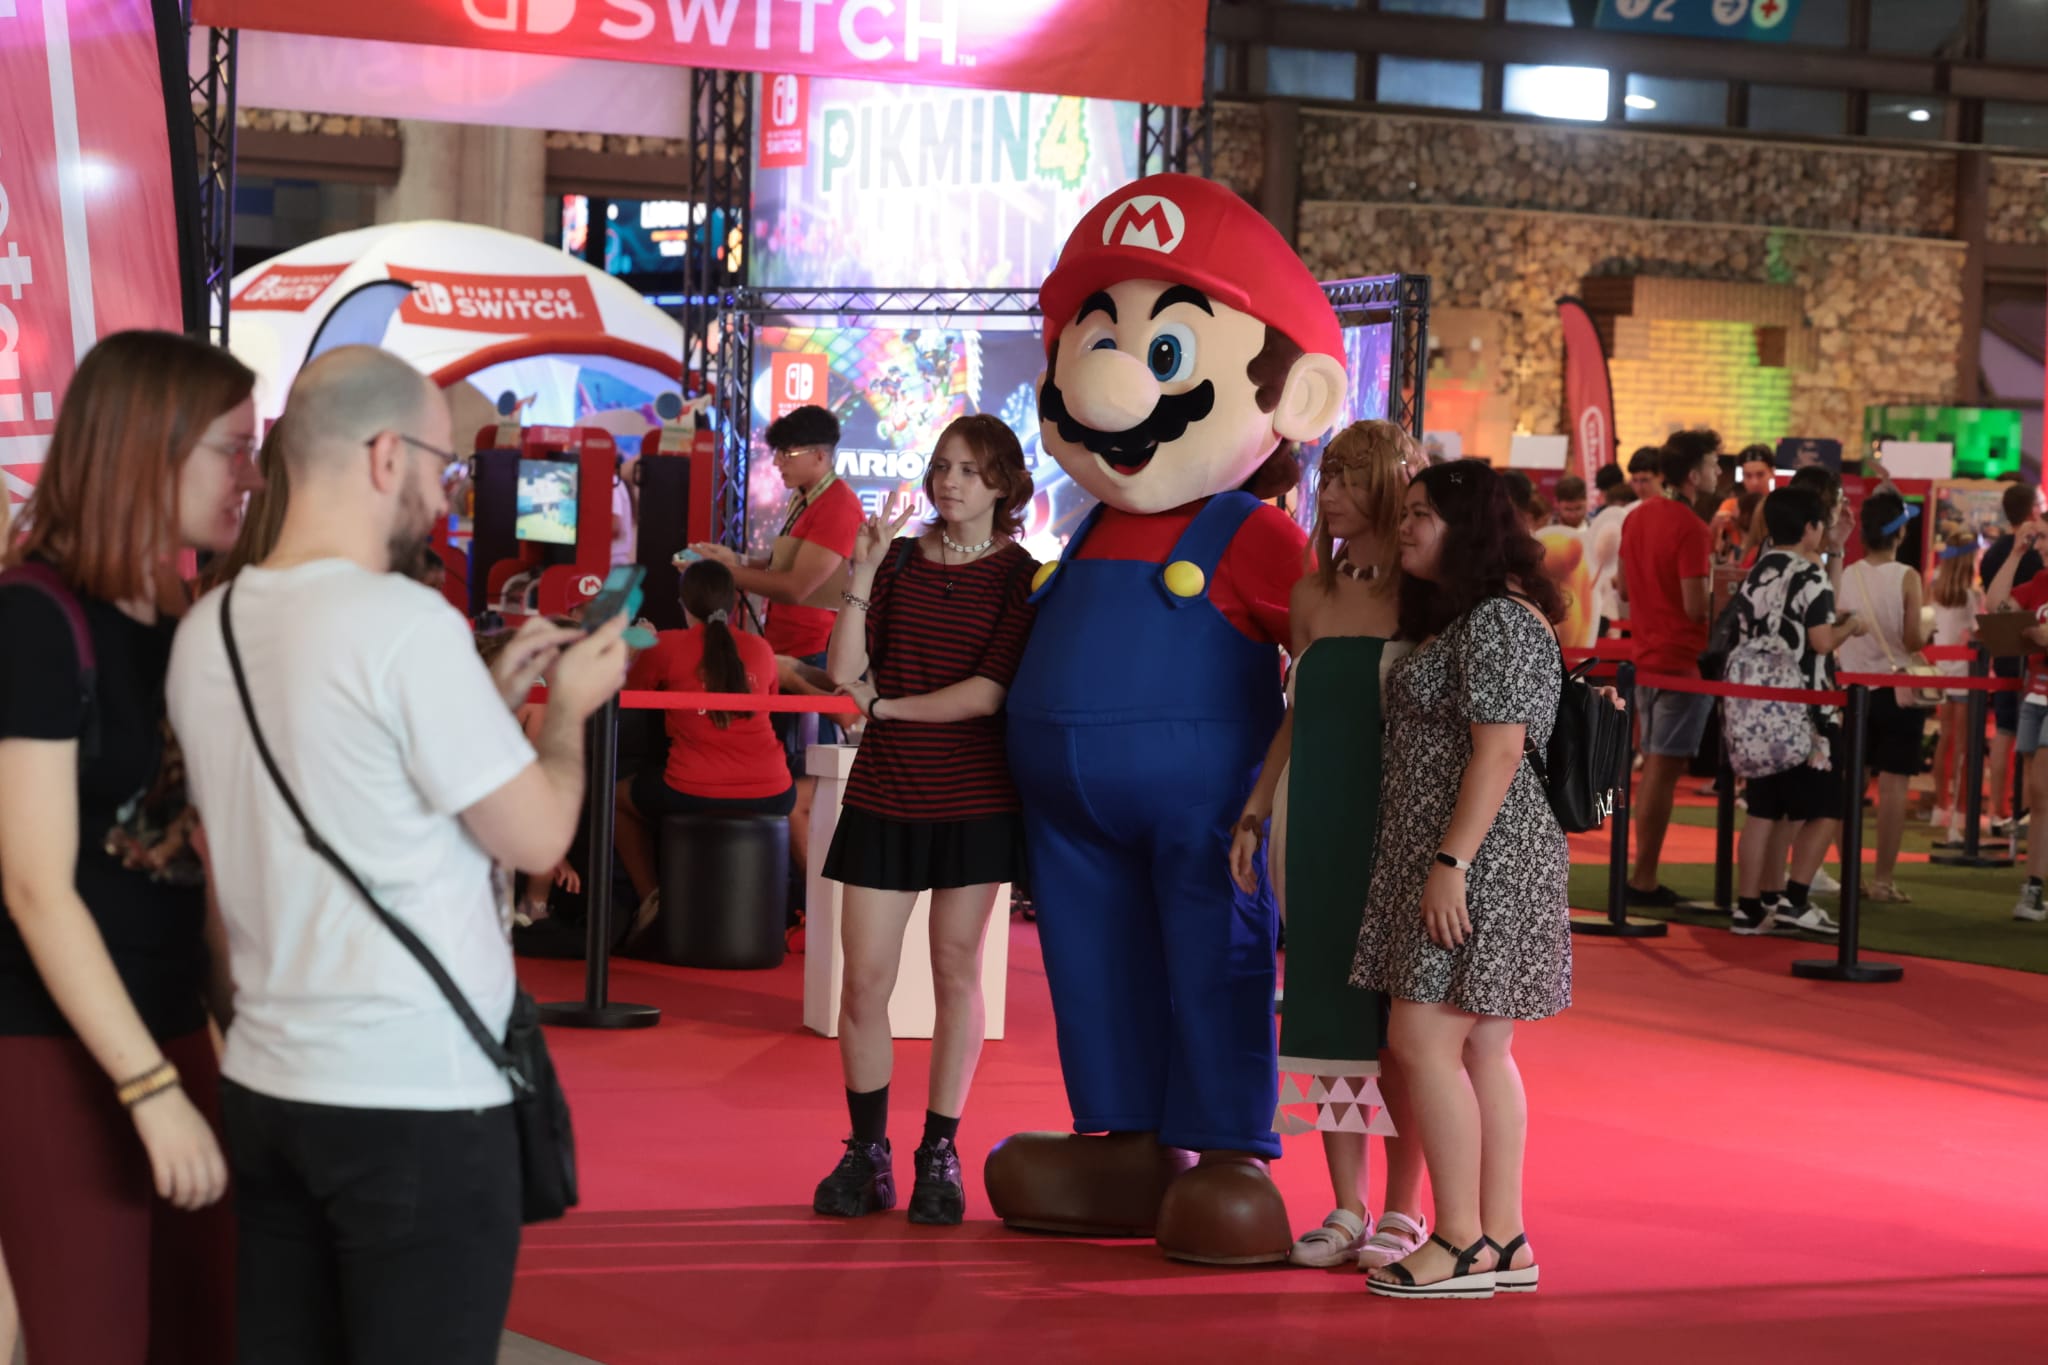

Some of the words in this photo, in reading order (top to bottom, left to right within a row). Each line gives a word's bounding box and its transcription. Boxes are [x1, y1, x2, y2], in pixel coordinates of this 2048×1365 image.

[599, 0, 956, 65] SWITCH
[822, 94, 1031, 192] PIKMIN
[1036, 95, 1090, 188] 4
[1108, 200, 1175, 248] M
[453, 285, 572, 300] NINTENDO
[457, 298, 577, 320] SWITCH
[836, 451, 924, 479] ARIO
